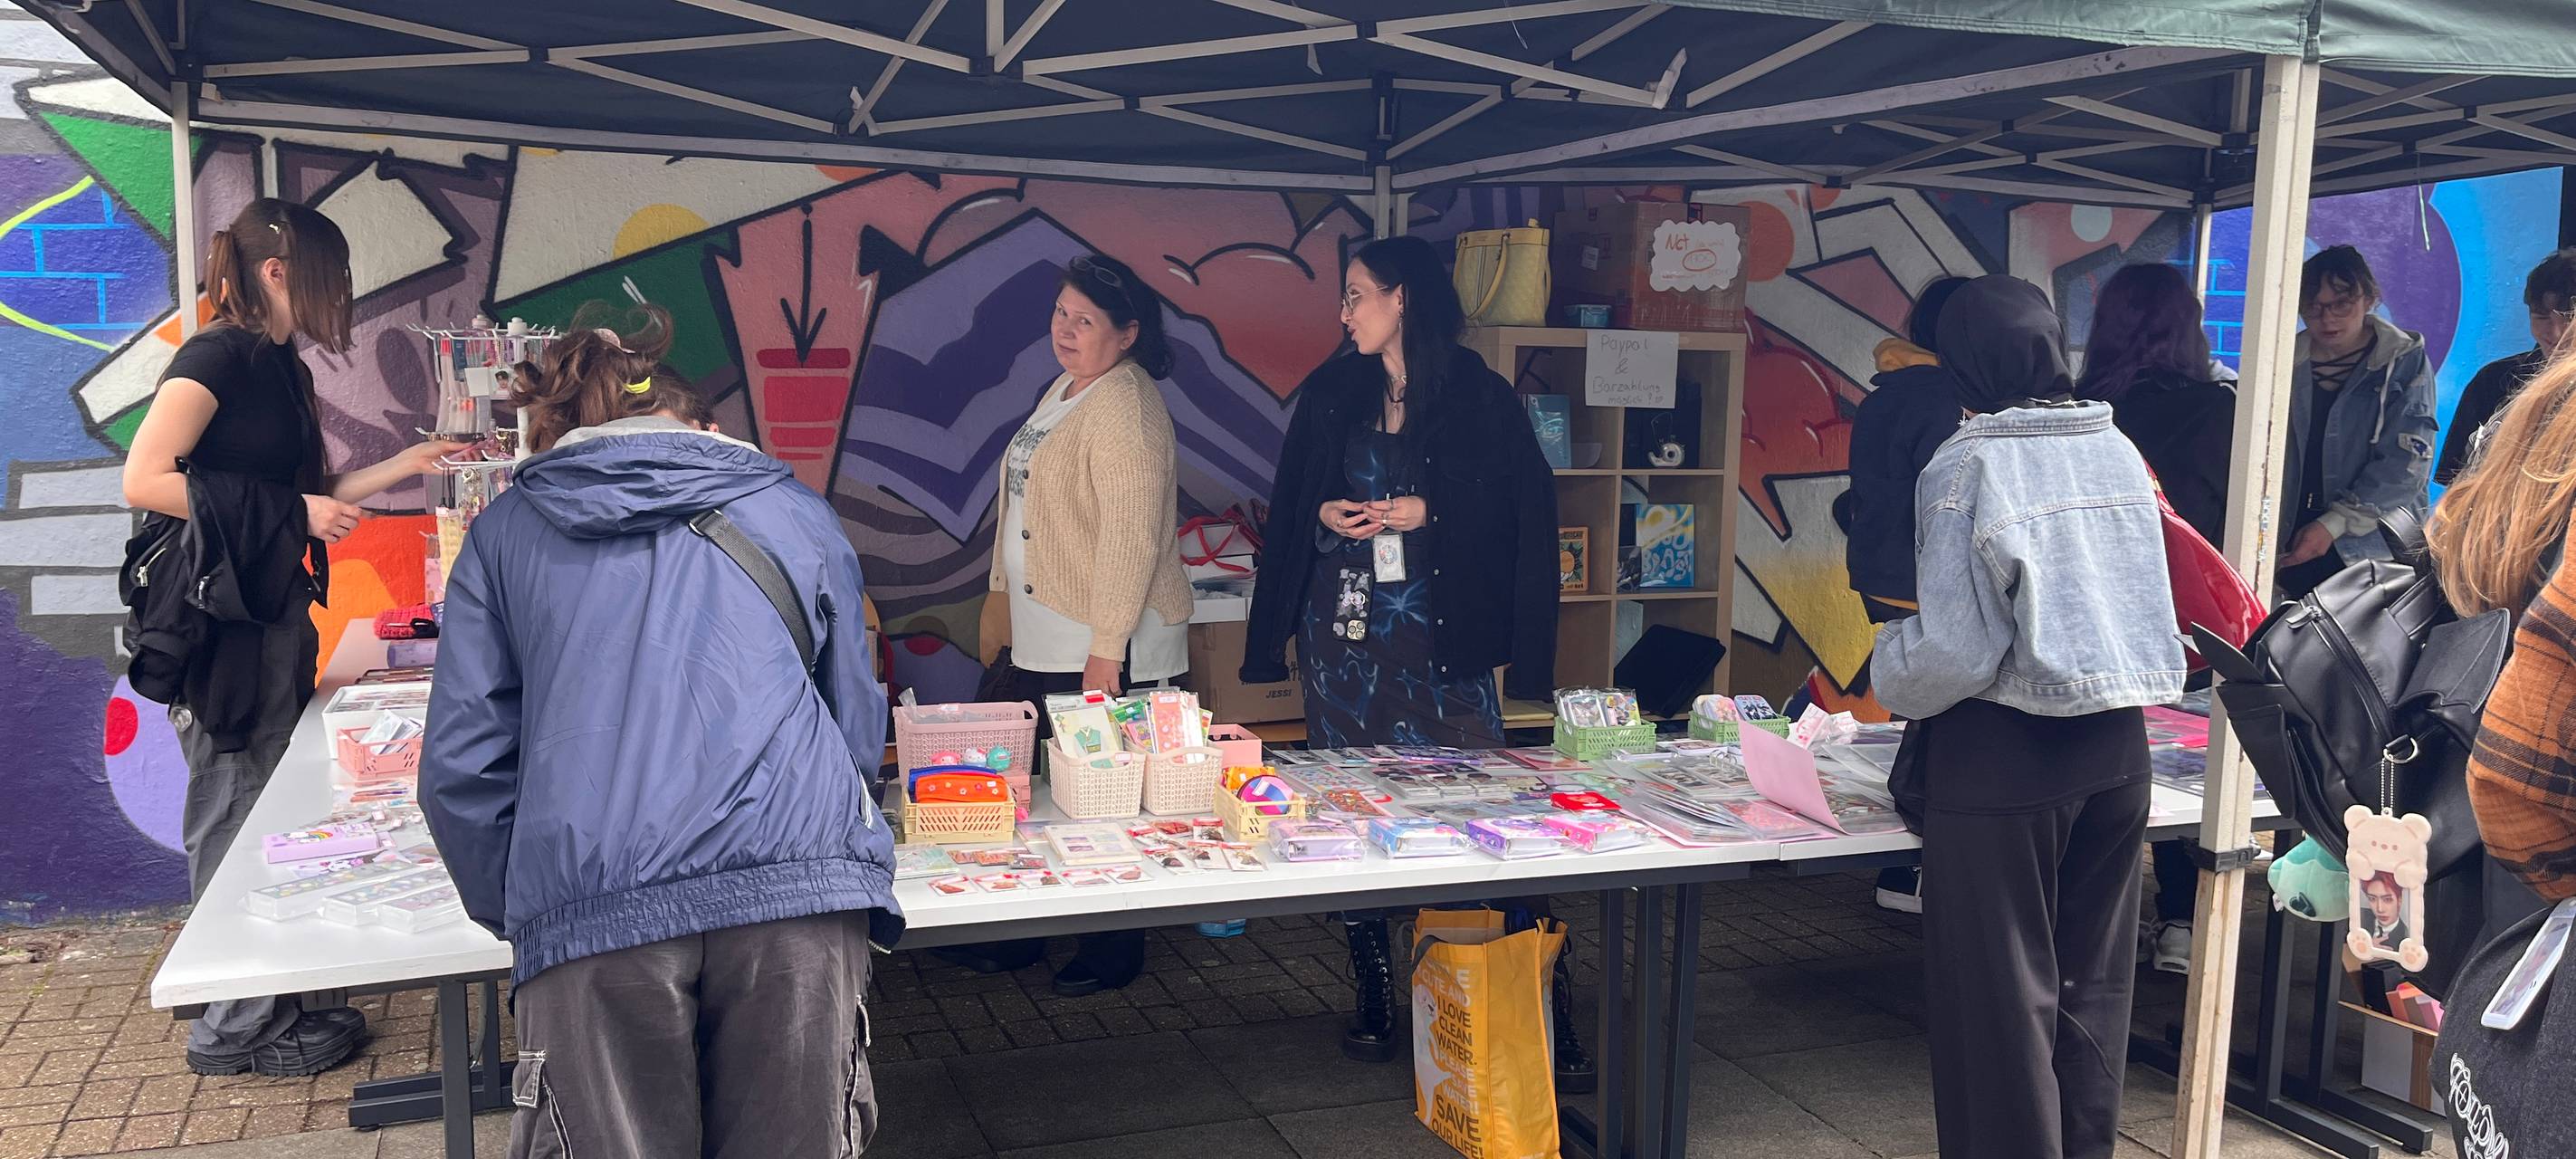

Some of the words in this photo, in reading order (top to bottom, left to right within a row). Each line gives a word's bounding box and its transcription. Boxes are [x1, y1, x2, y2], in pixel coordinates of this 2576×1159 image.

[1615, 357, 1629, 375] &
[1592, 375, 1661, 394] Barzahlung
[1265, 688, 1293, 699] JESSI
[1437, 995, 1441, 1011] I
[1443, 999, 1471, 1028] LOVE
[1439, 1015, 1473, 1047] CLEAN
[1436, 1030, 1478, 1066] WATER.
[1432, 1118, 1454, 1145] OUR
[1436, 1094, 1482, 1143] SAVE
